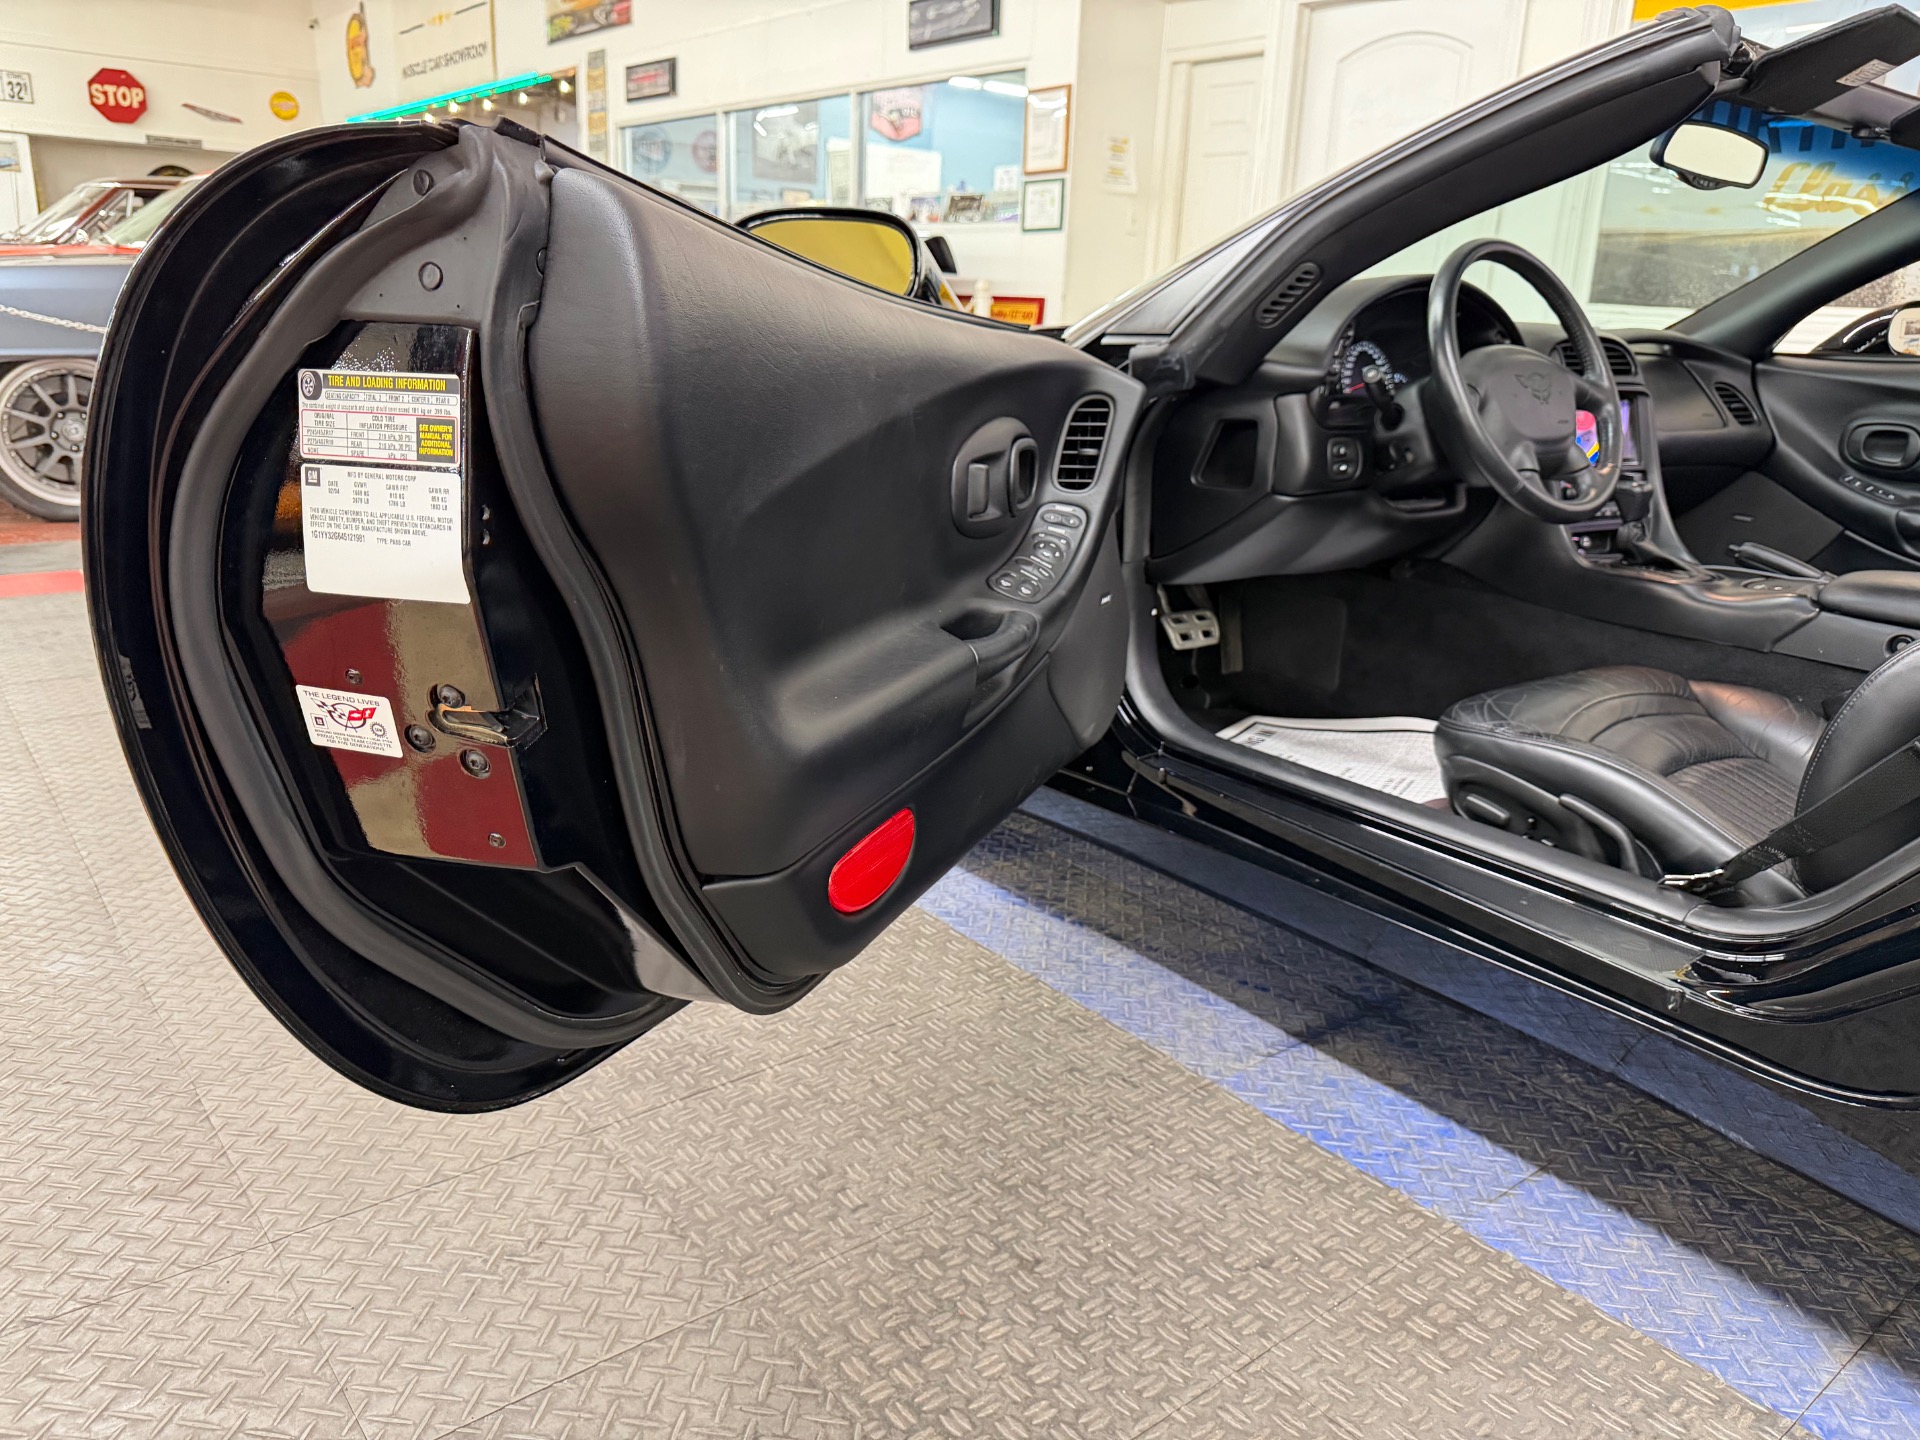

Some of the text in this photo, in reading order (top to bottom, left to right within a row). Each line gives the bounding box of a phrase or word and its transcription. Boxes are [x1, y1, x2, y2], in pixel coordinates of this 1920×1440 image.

[90, 83, 145, 109] STOP
[328, 375, 446, 391] TIRE AND LOADING INFORMATION
[359, 422, 382, 430] INFLATION
[420, 432, 441, 440] MANUAL
[421, 440, 451, 448] ADDITIONAL
[419, 448, 453, 456] INFORMATION
[308, 470, 317, 480] GM
[364, 472, 384, 480] GENERAL
[380, 512, 404, 520] APPLICABLE
[416, 515, 435, 523] FEDERAL
[391, 520, 418, 528] PREVENTION
[361, 525, 393, 534] MANUFACTURE
[303, 690, 380, 706] THE LEGEND LIVES
